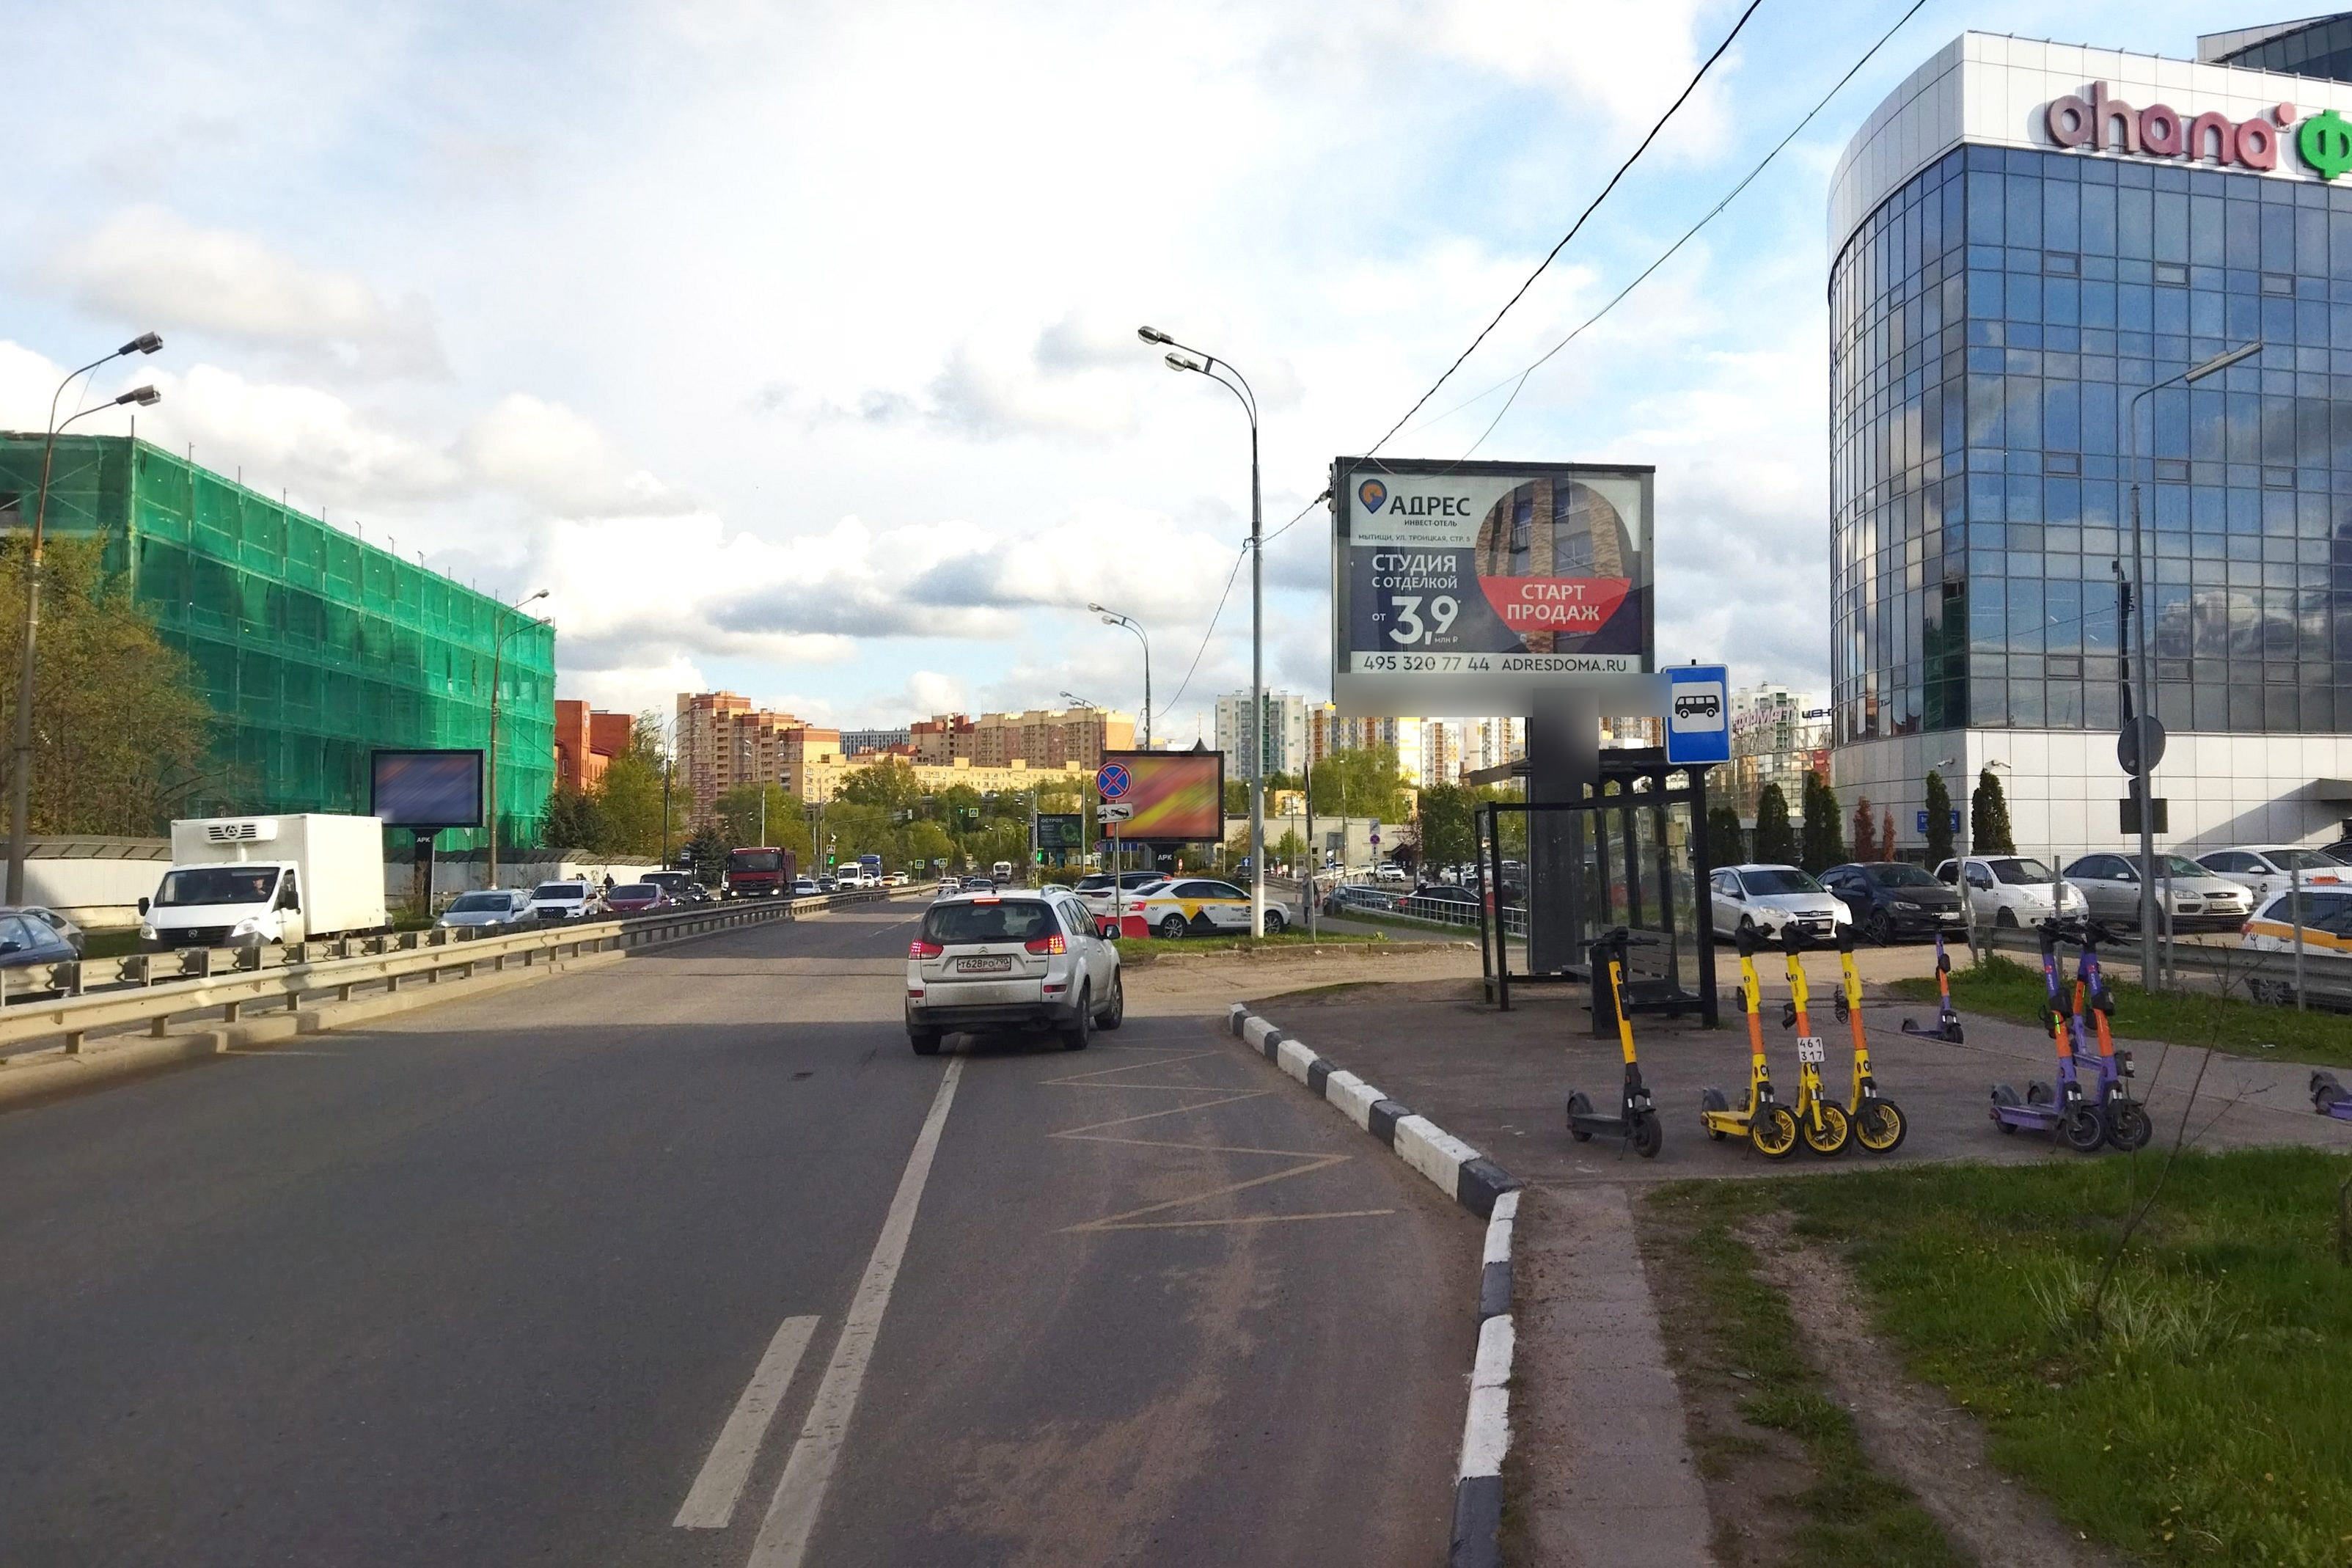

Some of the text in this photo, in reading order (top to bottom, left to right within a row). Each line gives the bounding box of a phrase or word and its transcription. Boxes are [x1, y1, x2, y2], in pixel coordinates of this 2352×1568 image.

[1389, 496, 1470, 516] АДРЕС
[1358, 534, 1393, 542] МЫТИЩИ,
[1372, 554, 1457, 576] СТУДИЯ
[1371, 575, 1458, 591] С ОТДЕЛКОЙ
[1521, 584, 1586, 600] СТАРТ
[1507, 604, 1600, 624] ПРОДАЖ
[1363, 656, 1627, 672] 495 320 77 44 ADRESDOMA.RU
[1799, 1038, 1821, 1048] 461
[1801, 1051, 1822, 1060] 317
